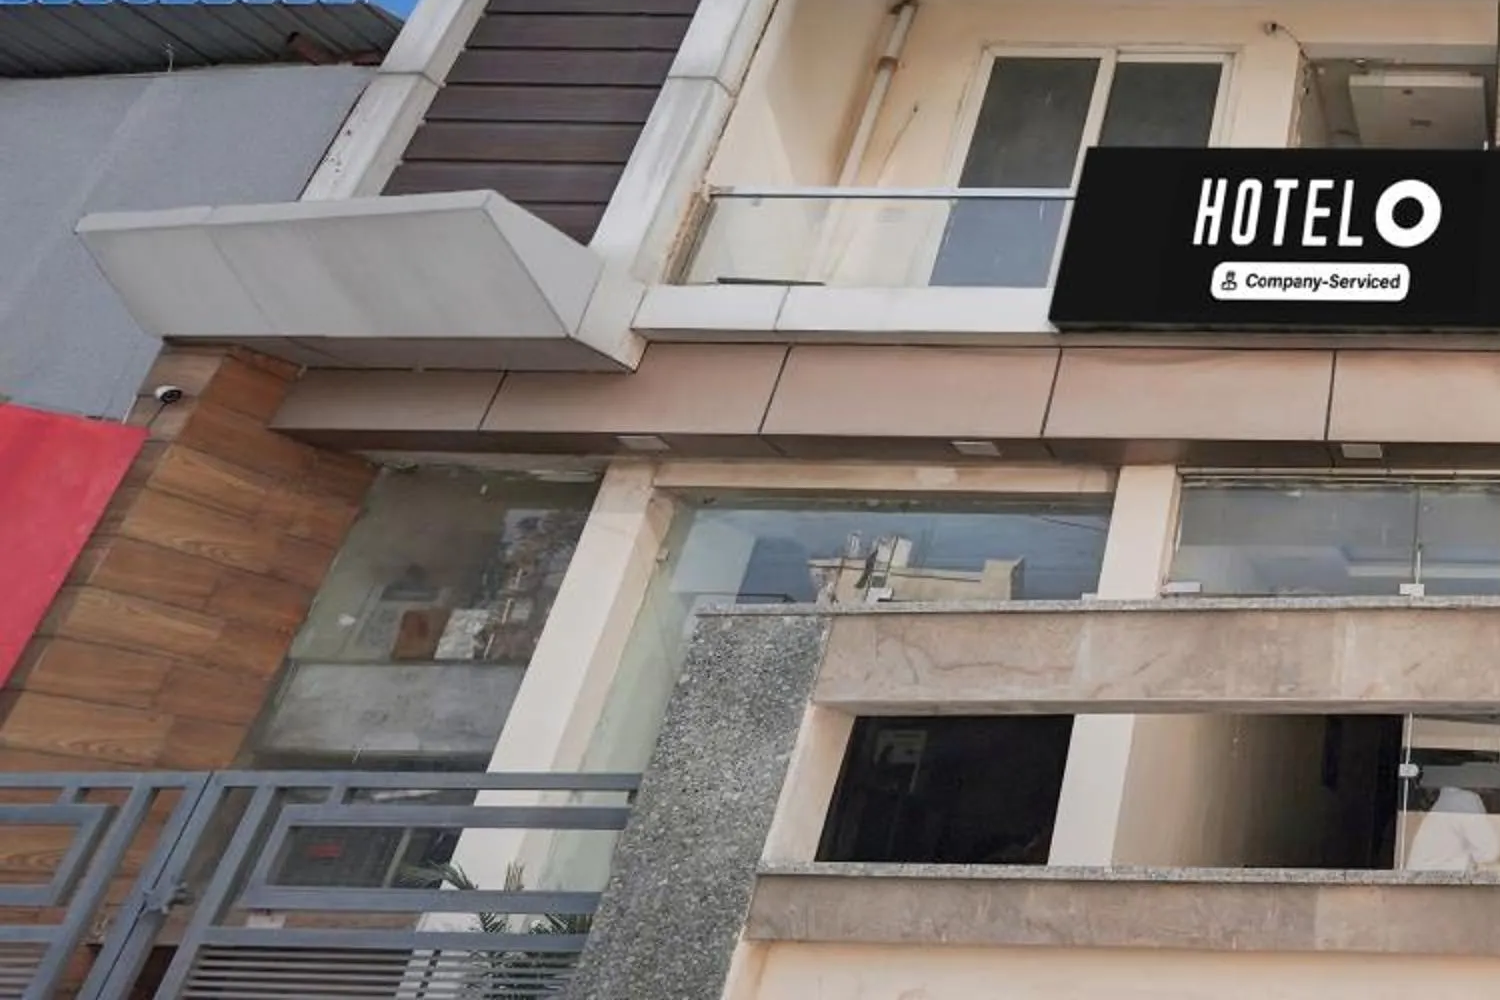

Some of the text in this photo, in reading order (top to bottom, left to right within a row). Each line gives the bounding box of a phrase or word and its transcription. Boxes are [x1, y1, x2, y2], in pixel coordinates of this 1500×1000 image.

[1193, 179, 1441, 247] HOTEL O
[1246, 274, 1400, 291] Company-Serviced
